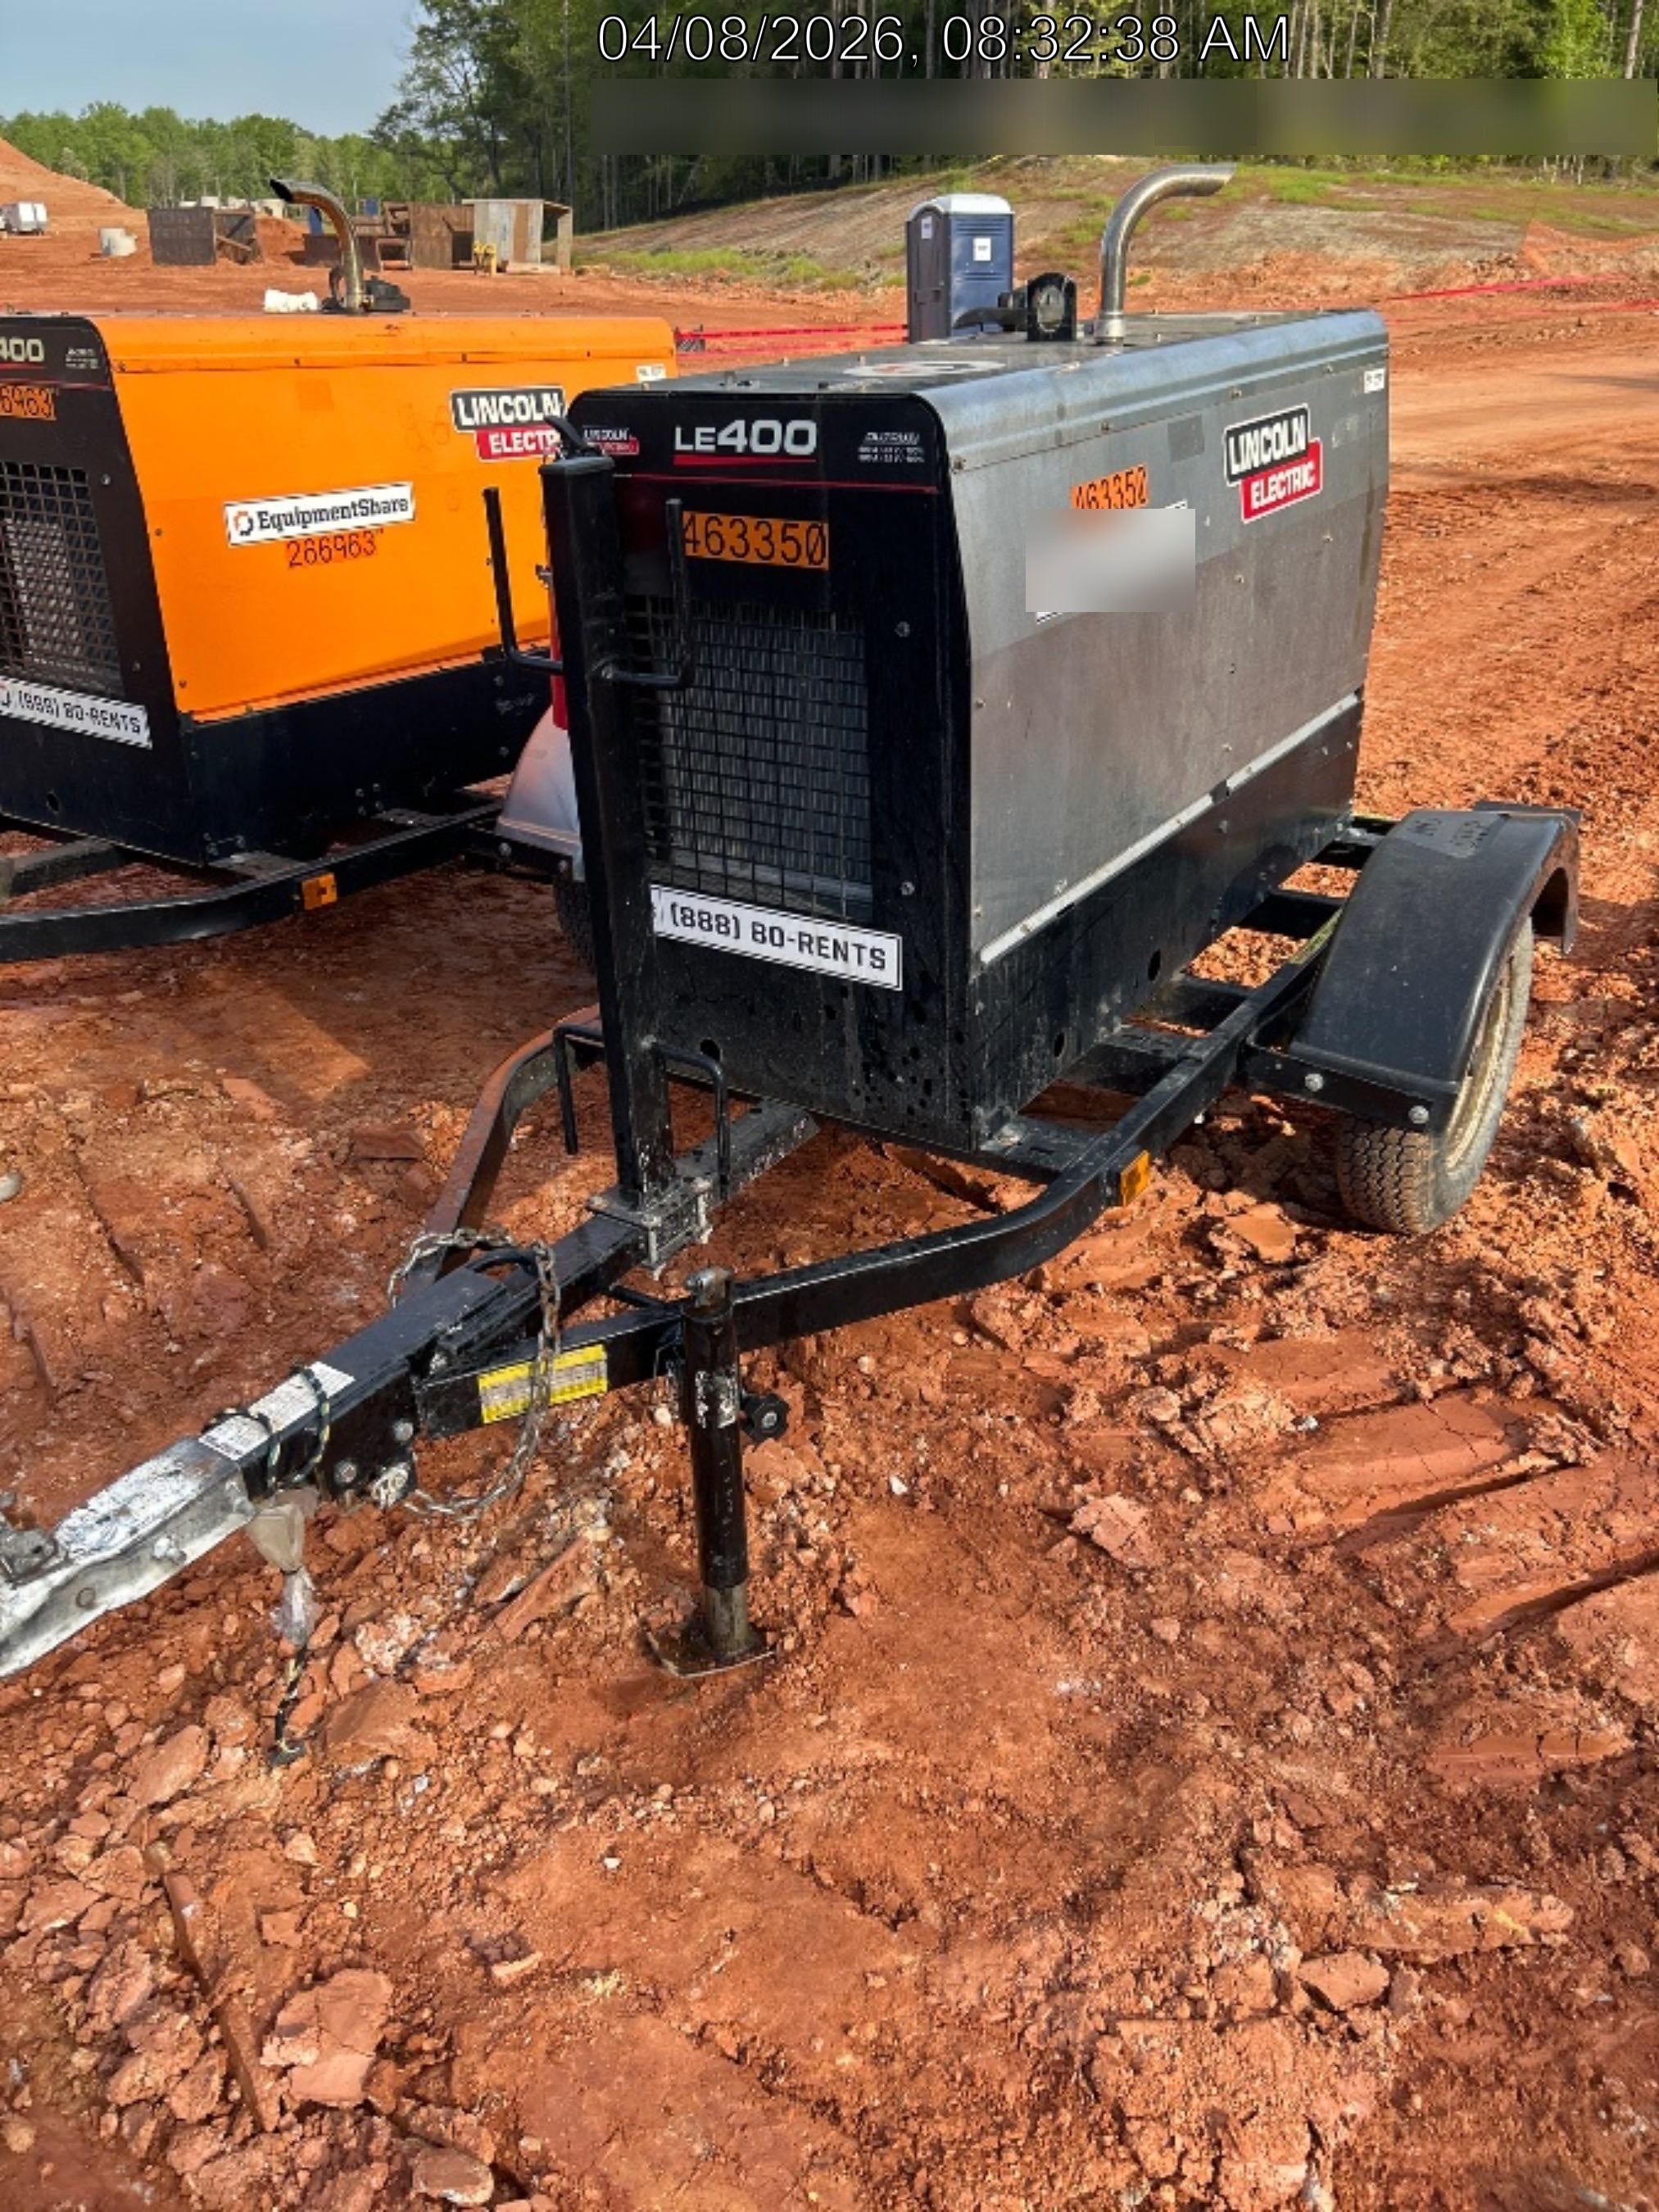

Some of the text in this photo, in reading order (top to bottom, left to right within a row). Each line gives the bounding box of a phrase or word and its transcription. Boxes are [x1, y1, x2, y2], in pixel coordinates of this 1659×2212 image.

[456, 392, 560, 426] LINCOLN
[489, 429, 561, 455] ELECTR
[675, 419, 818, 456] LE400
[1229, 415, 1307, 475] LINCOLN
[1251, 461, 1316, 510] ELECTRIC
[257, 498, 409, 532] EquipmentShare
[288, 530, 376, 568] 266963
[684, 514, 827, 566] 463350
[670, 901, 741, 940] (888)
